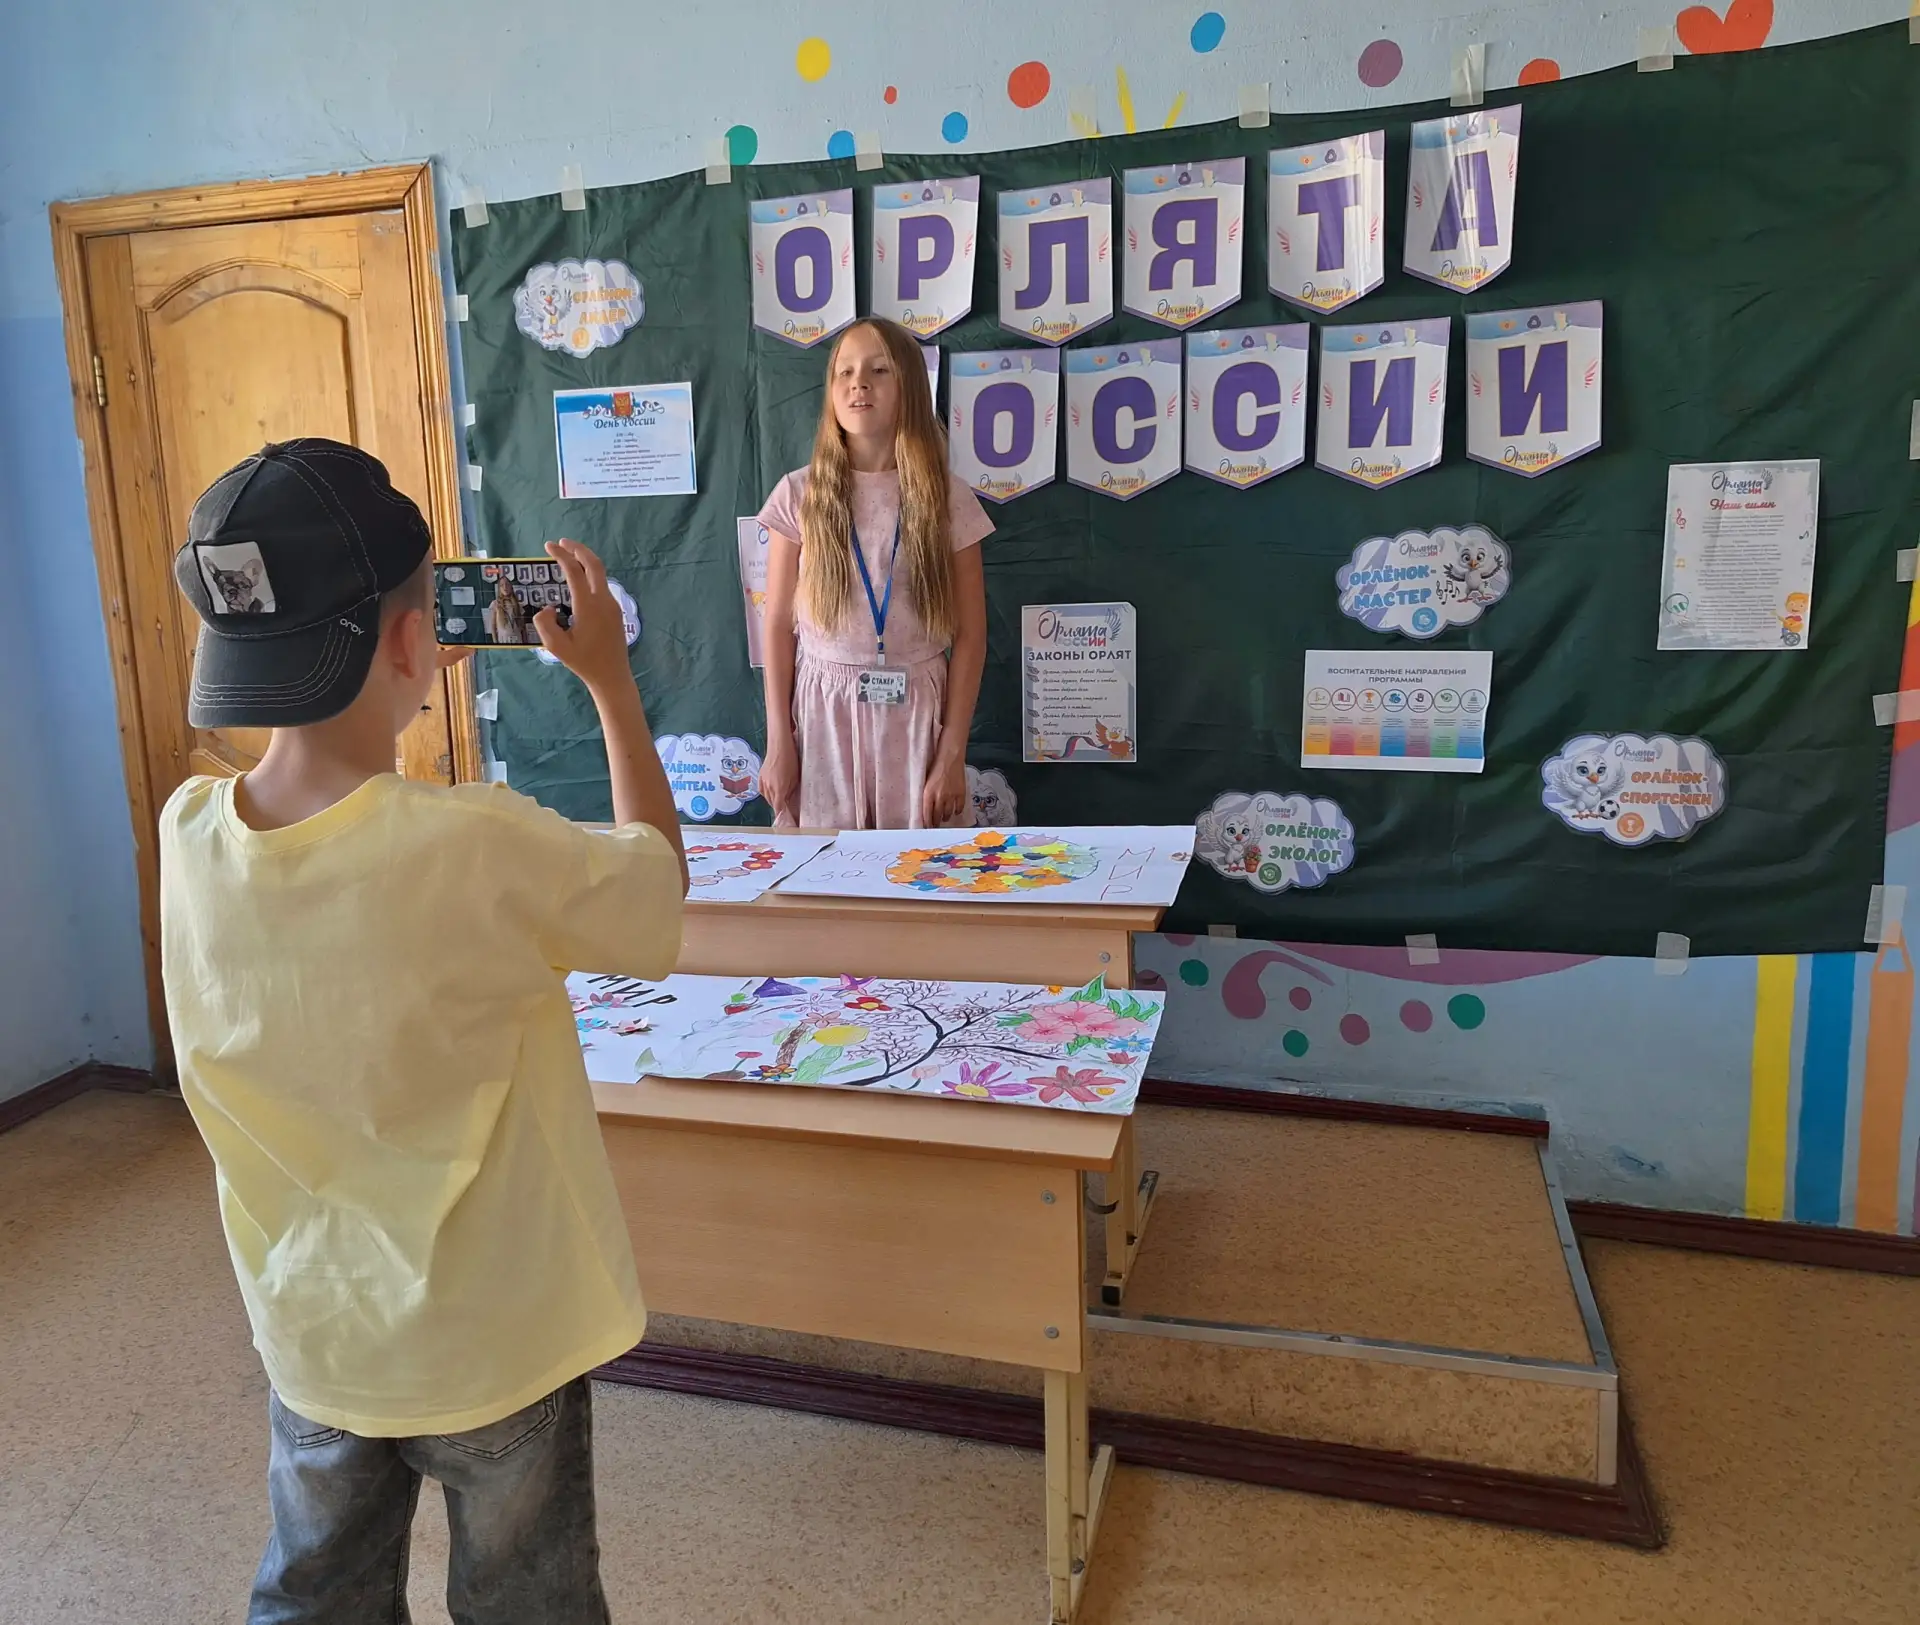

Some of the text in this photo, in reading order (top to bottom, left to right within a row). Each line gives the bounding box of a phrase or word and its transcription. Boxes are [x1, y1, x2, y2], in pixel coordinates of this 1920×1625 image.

[593, 416, 656, 429] День России
[1710, 498, 1741, 510] Наш
[1350, 564, 1437, 586] ОРЛЁНОК-
[1354, 587, 1432, 610] МАСТЕР
[1028, 649, 1131, 661] ЗАКОНЫ ОРЛЯТ
[663, 761, 711, 774] РЛЁНОК-
[1631, 768, 1708, 785] ОРЛЁНОК-
[1619, 791, 1713, 806] СПОРТСМЕН
[1265, 822, 1348, 840] ОРЛЁНОК-
[1268, 845, 1342, 862] ЭКОЛОГ
